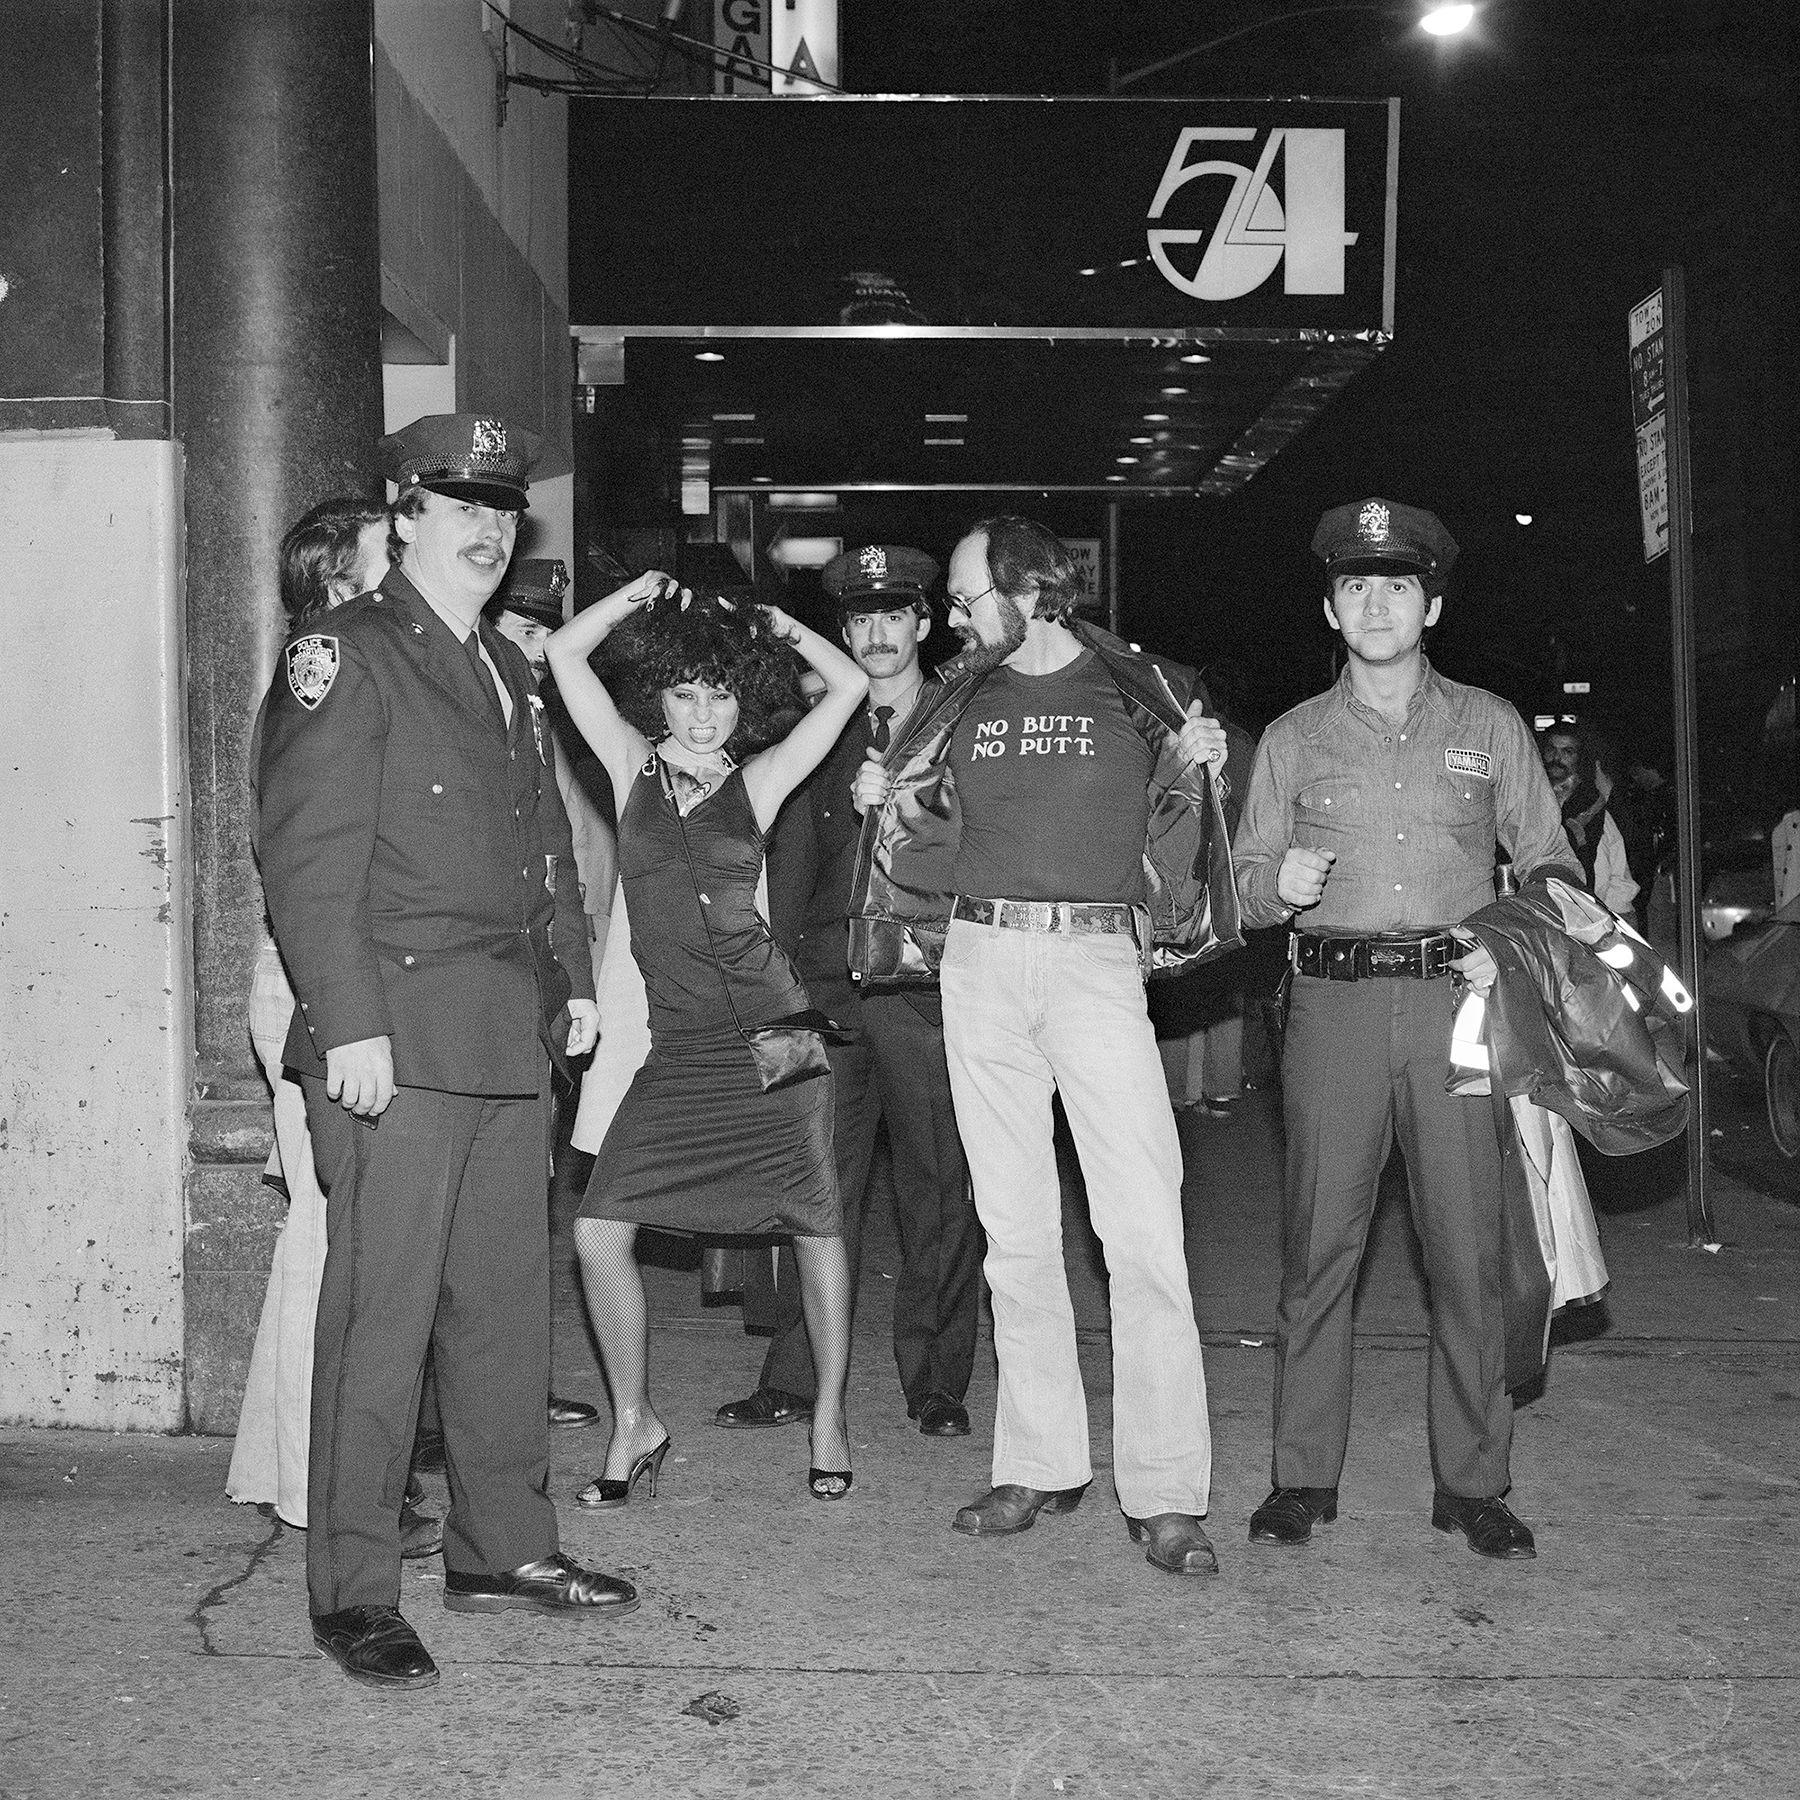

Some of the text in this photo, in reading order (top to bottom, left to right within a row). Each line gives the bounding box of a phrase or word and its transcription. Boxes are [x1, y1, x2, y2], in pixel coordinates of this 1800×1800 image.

[1146, 127, 1359, 301] 54
[1070, 547, 1091, 560] OW
[297, 638, 322, 652] POLICE
[975, 715, 1095, 740] NO BUTT
[971, 737, 1095, 762] NO PUTT.
[1451, 755, 1488, 771] YAMAHA
